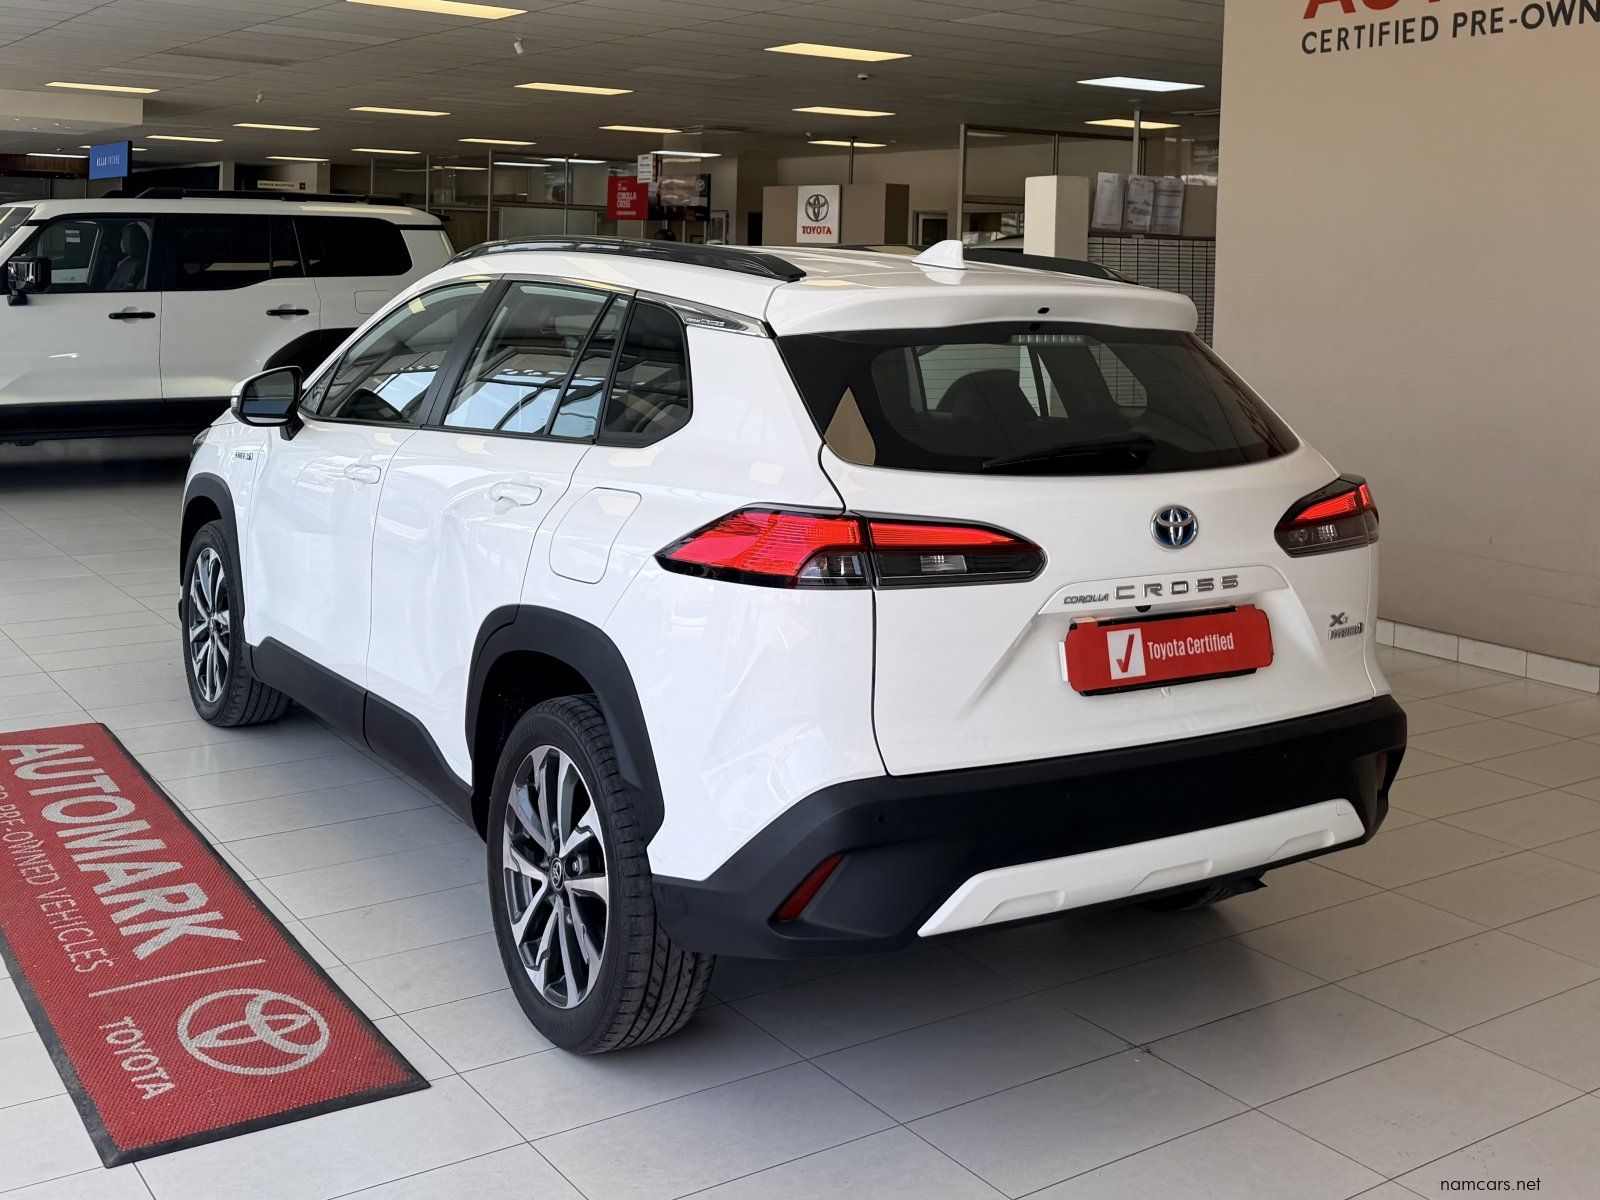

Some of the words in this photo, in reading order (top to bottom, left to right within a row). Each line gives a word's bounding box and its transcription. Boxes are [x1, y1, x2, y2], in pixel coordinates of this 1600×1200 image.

[1301, 15, 1439, 55] CERTIFIED
[801, 226, 832, 235] TOYOTA
[1063, 593, 1110, 604] COROLLA
[1114, 575, 1239, 600] CROSS
[1147, 641, 1186, 661] Toyota
[1187, 632, 1235, 653] Certified
[0, 743, 243, 961] AUTOMARK
[35, 886, 114, 974] VEHICLES
[98, 1015, 176, 1100] TOYOTA
